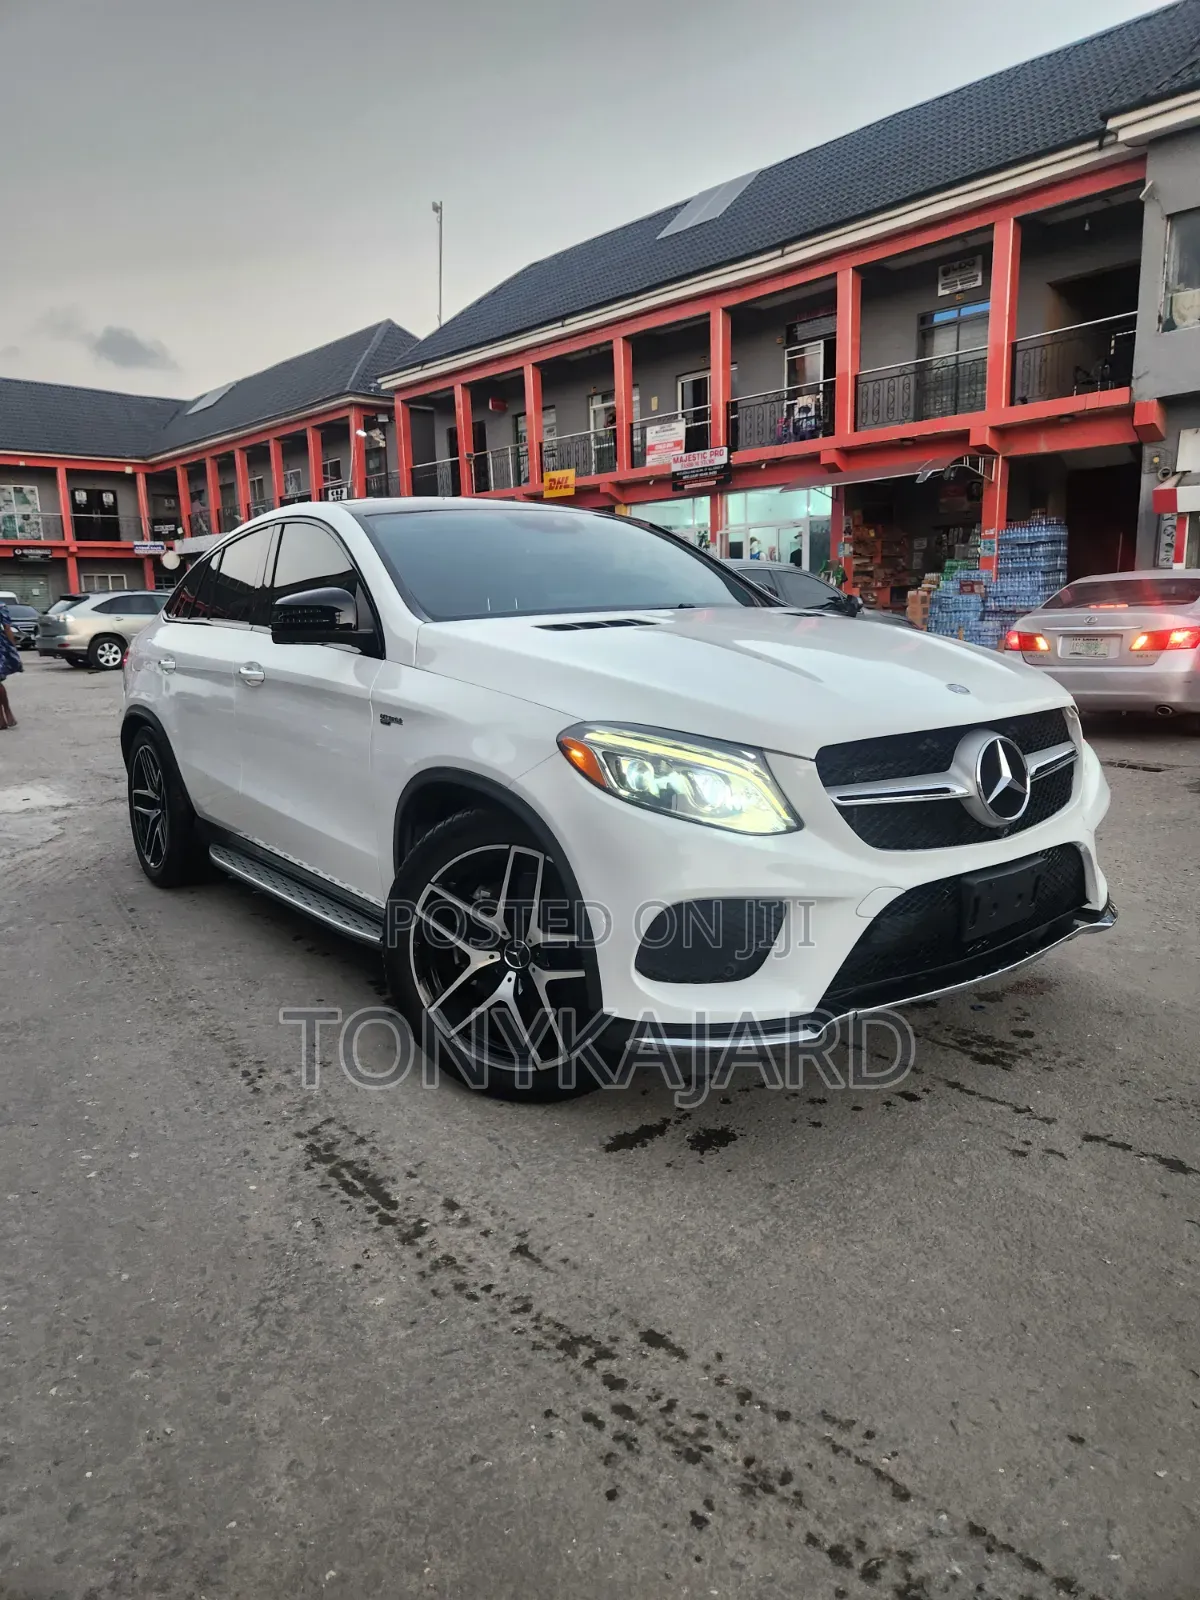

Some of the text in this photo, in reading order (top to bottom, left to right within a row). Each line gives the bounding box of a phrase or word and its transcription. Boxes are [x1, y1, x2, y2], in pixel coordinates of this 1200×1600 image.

[672, 452, 707, 464] MAJESTIC
[709, 449, 724, 458] PRO
[548, 476, 570, 490] DHL
